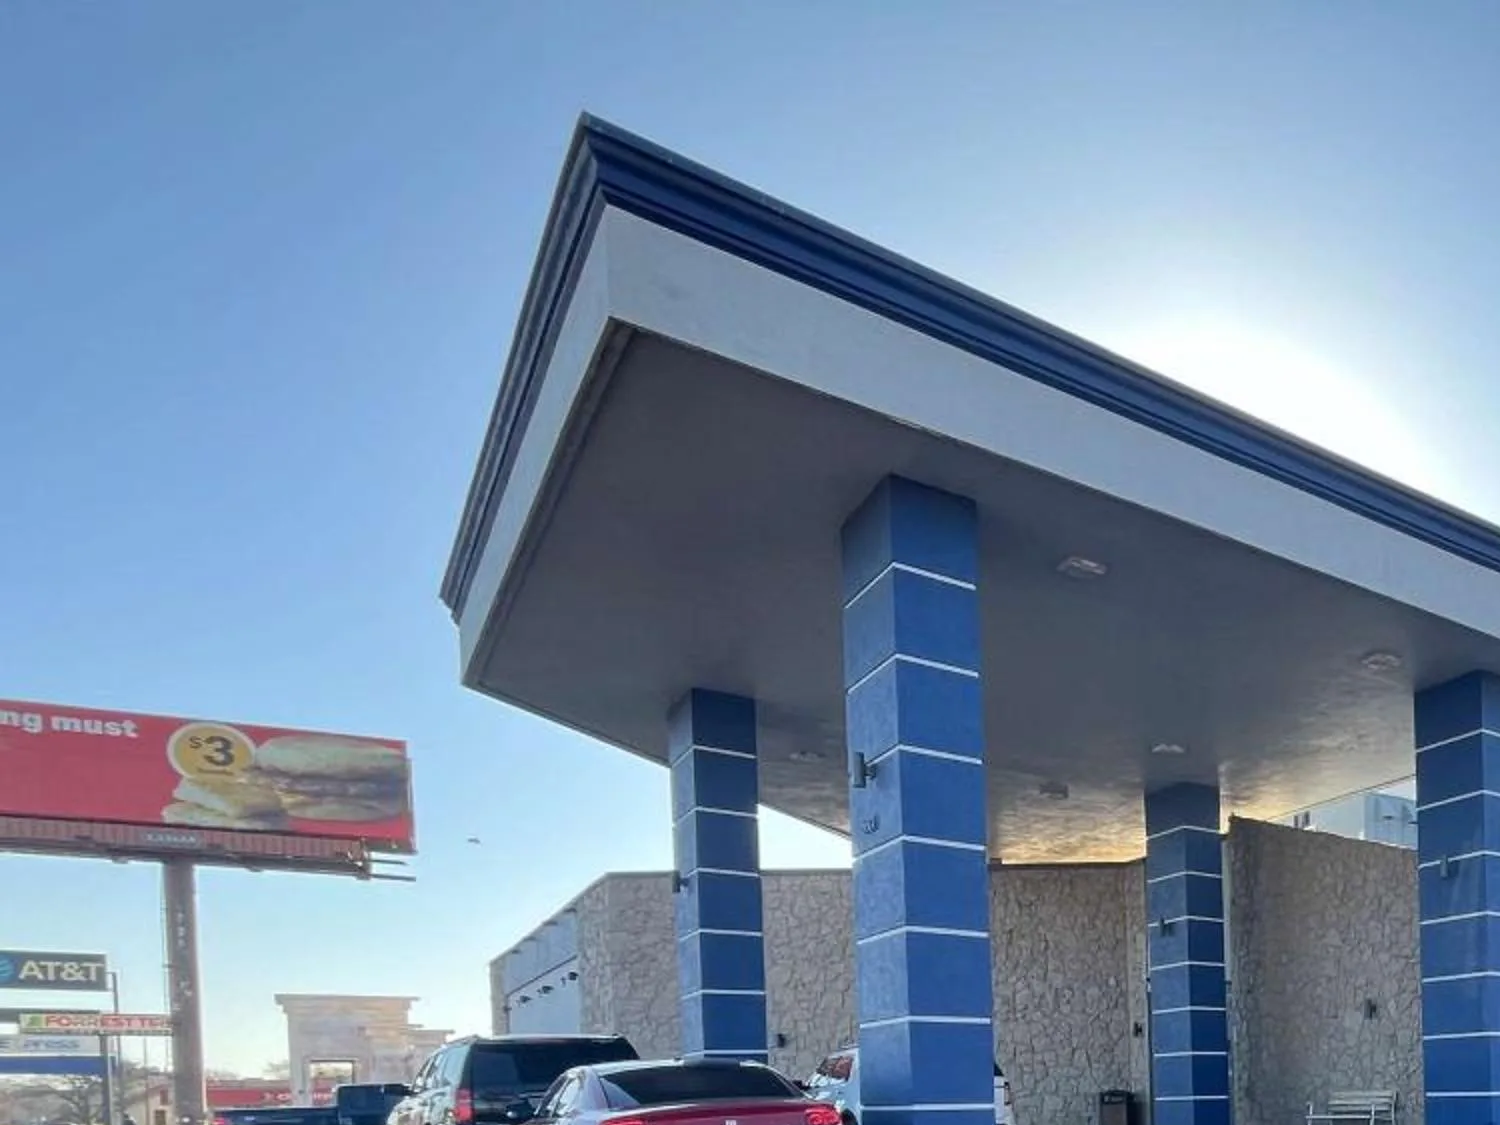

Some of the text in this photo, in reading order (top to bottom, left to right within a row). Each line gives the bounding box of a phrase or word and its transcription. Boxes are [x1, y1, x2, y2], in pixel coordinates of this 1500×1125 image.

[51, 715, 138, 737] must
[188, 735, 234, 766] $3
[18, 959, 105, 982] AT&T
